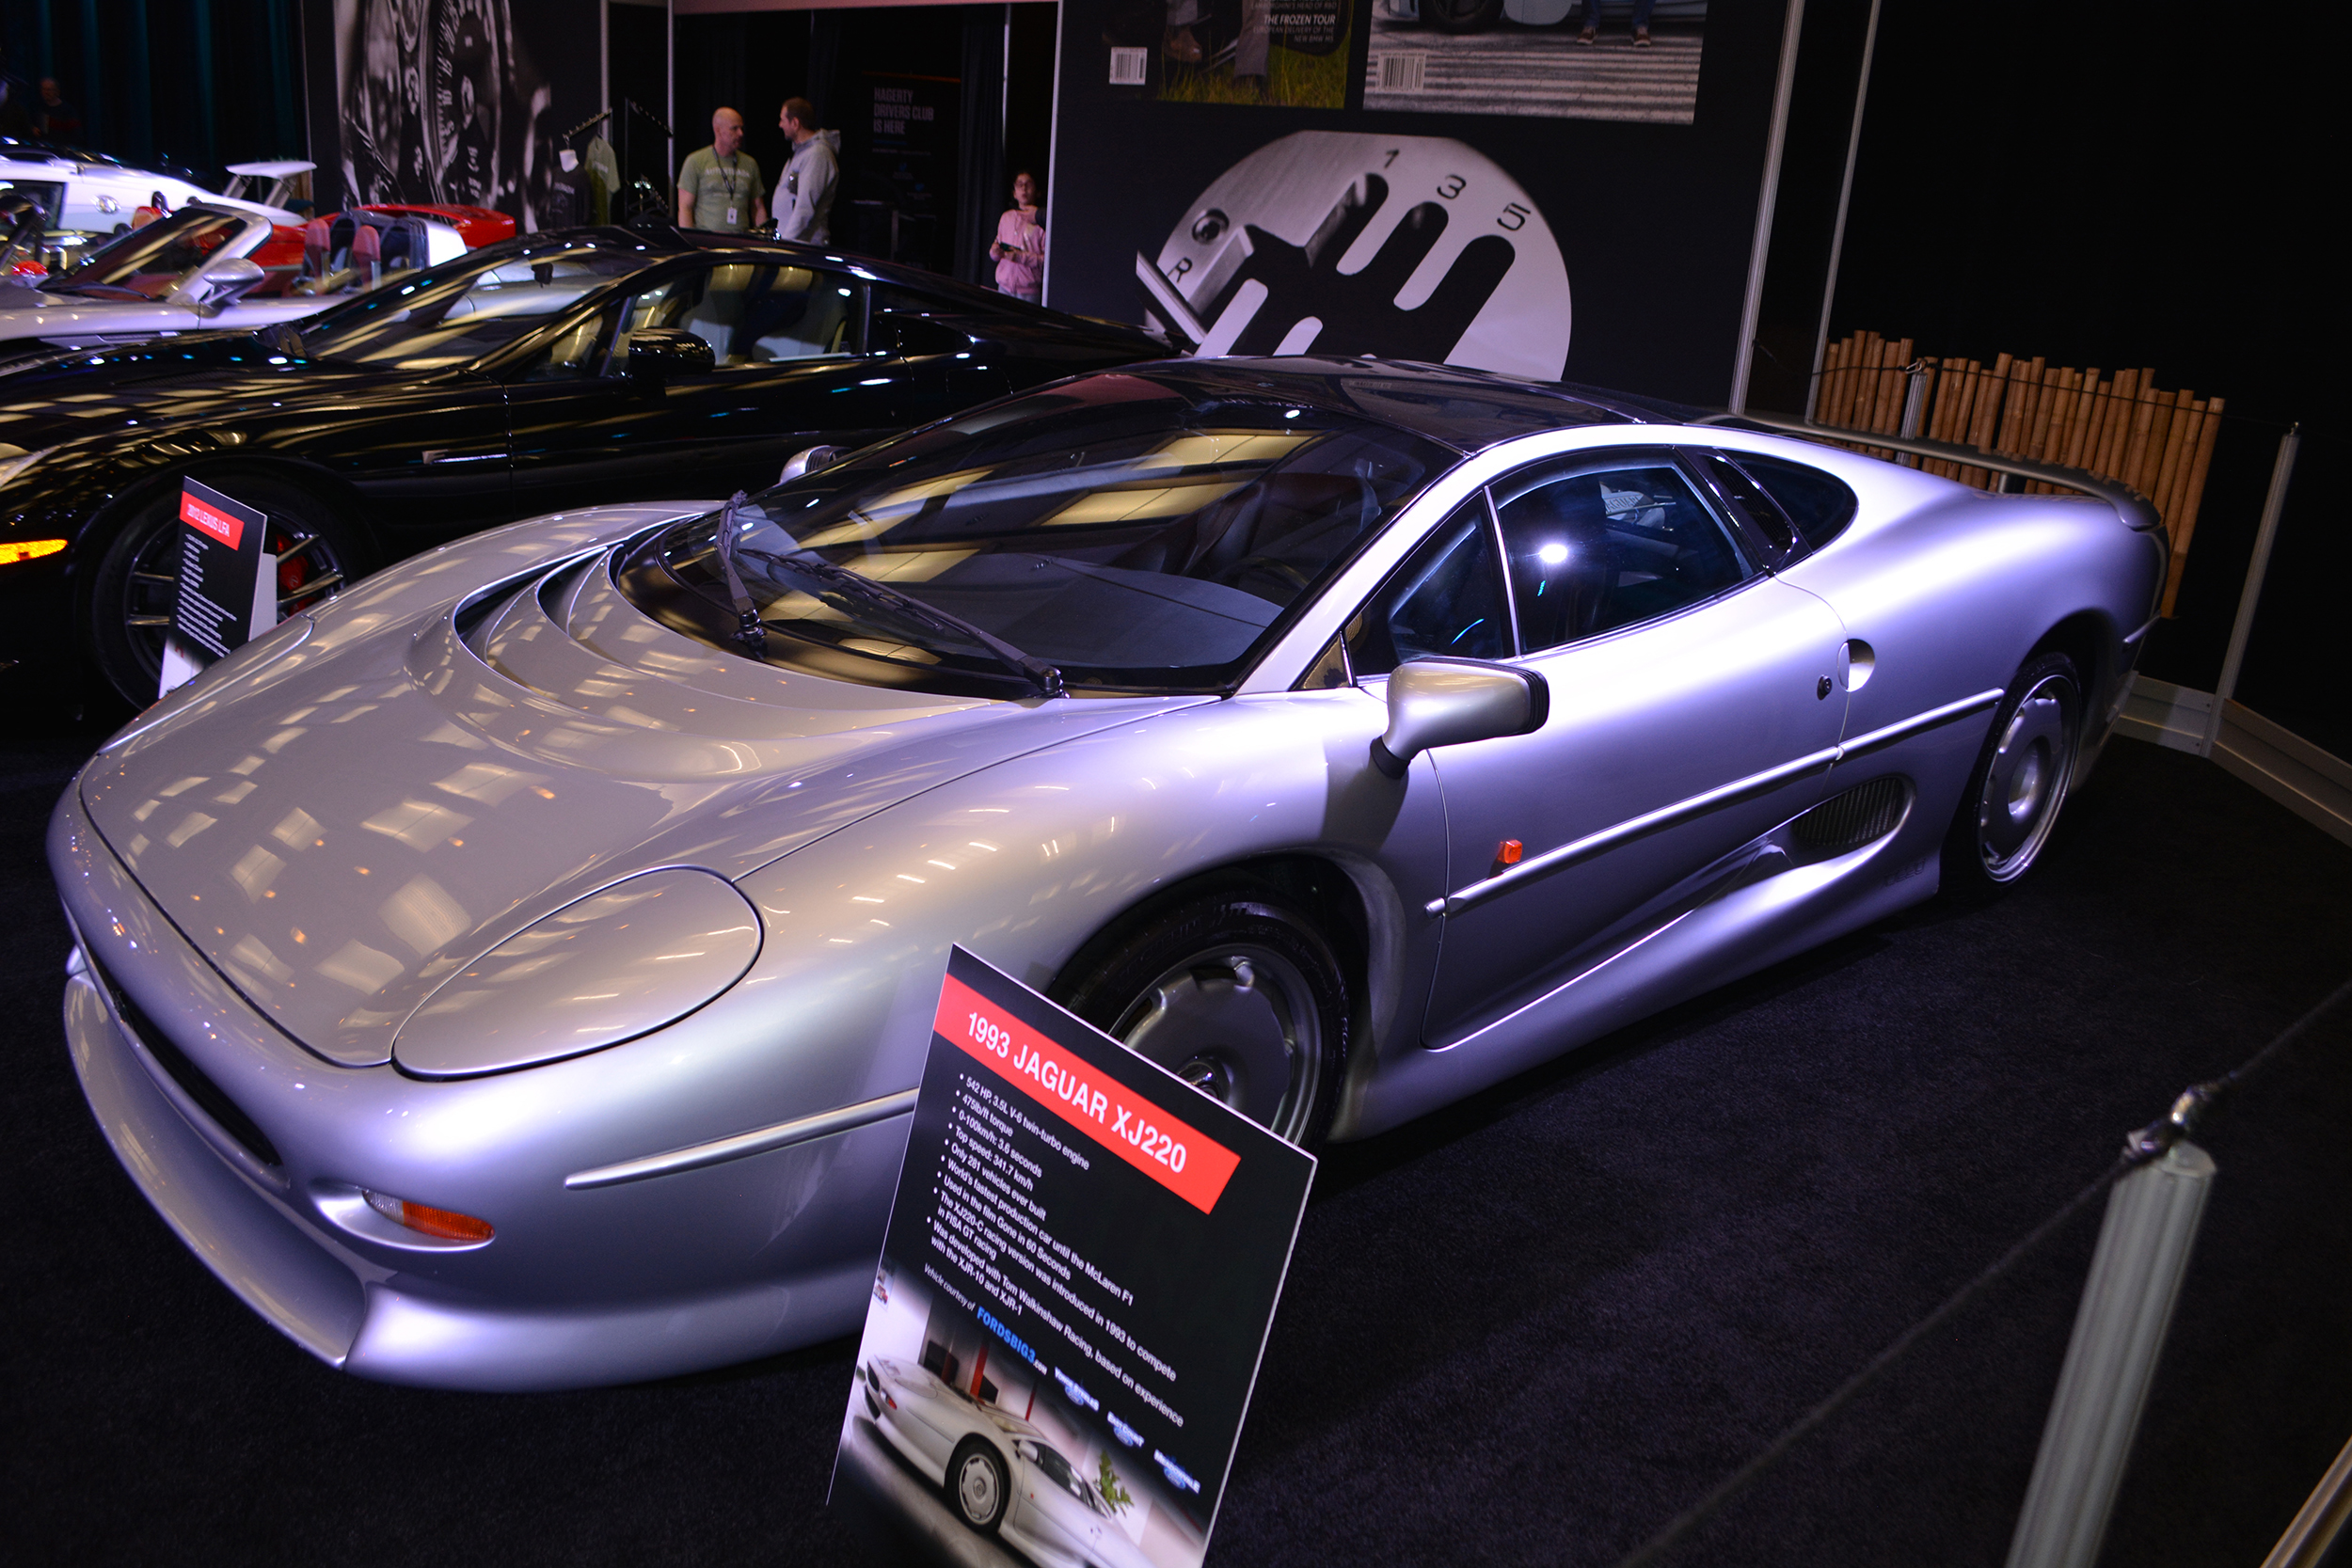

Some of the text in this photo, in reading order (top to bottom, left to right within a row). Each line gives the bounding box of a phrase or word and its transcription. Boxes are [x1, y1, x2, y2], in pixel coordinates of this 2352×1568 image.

[1263, 14, 1336, 25] THE FROZEN TOUR
[1284, 25, 1312, 34] DELIVERY
[1312, 25, 1321, 34] OF
[1322, 25, 1335, 34] THE
[1293, 34, 1308, 43] NEW
[873, 87, 914, 104] HAGERTY
[873, 103, 934, 121] DRIVERS CLUB
[873, 118, 906, 135] IS HERE
[1384, 149, 1400, 169] 1
[1436, 174, 1468, 200] 3
[1496, 202, 1532, 231] 5
[1167, 257, 1193, 284] R
[199, 510, 218, 531] LEXUS
[217, 519, 230, 538] LFA
[968, 1012, 1186, 1173] 1993 JAGUAR XJ220
[961, 1094, 1013, 1136] 475lb/ft torque
[965, 1076, 1089, 1170] 542 HP, 3.5L V-6 twin-turbo engine
[956, 1125, 1033, 1191] Top speed: 341.7 km/h
[958, 1109, 1041, 1178] 0-100km/h: 3.6 seconds
[951, 1142, 1046, 1221] Only 281 vehicles ever built
[937, 1205, 997, 1260] in FISA GT racing
[944, 1174, 1071, 1280] Used in the film Gone in 60 Seconds
[947, 1158, 1133, 1306] World's fastest production car until the McLaren F1
[924, 1262, 944, 1286] Vehicle
[943, 1281, 968, 1307] courtesy
[966, 1301, 976, 1311] of
[930, 1236, 1022, 1315] with the XJR-10 and XJR-1
[941, 1190, 1176, 1381] The XJ220-C racing version was introduced in 1993 to compete
[933, 1219, 1184, 1427] Was developed with Tom Walkinshaw Racing, based on experience
[1106, 1411, 1144, 1447] EAST COURT
[1153, 1449, 1200, 1493] MEADOWVALE
